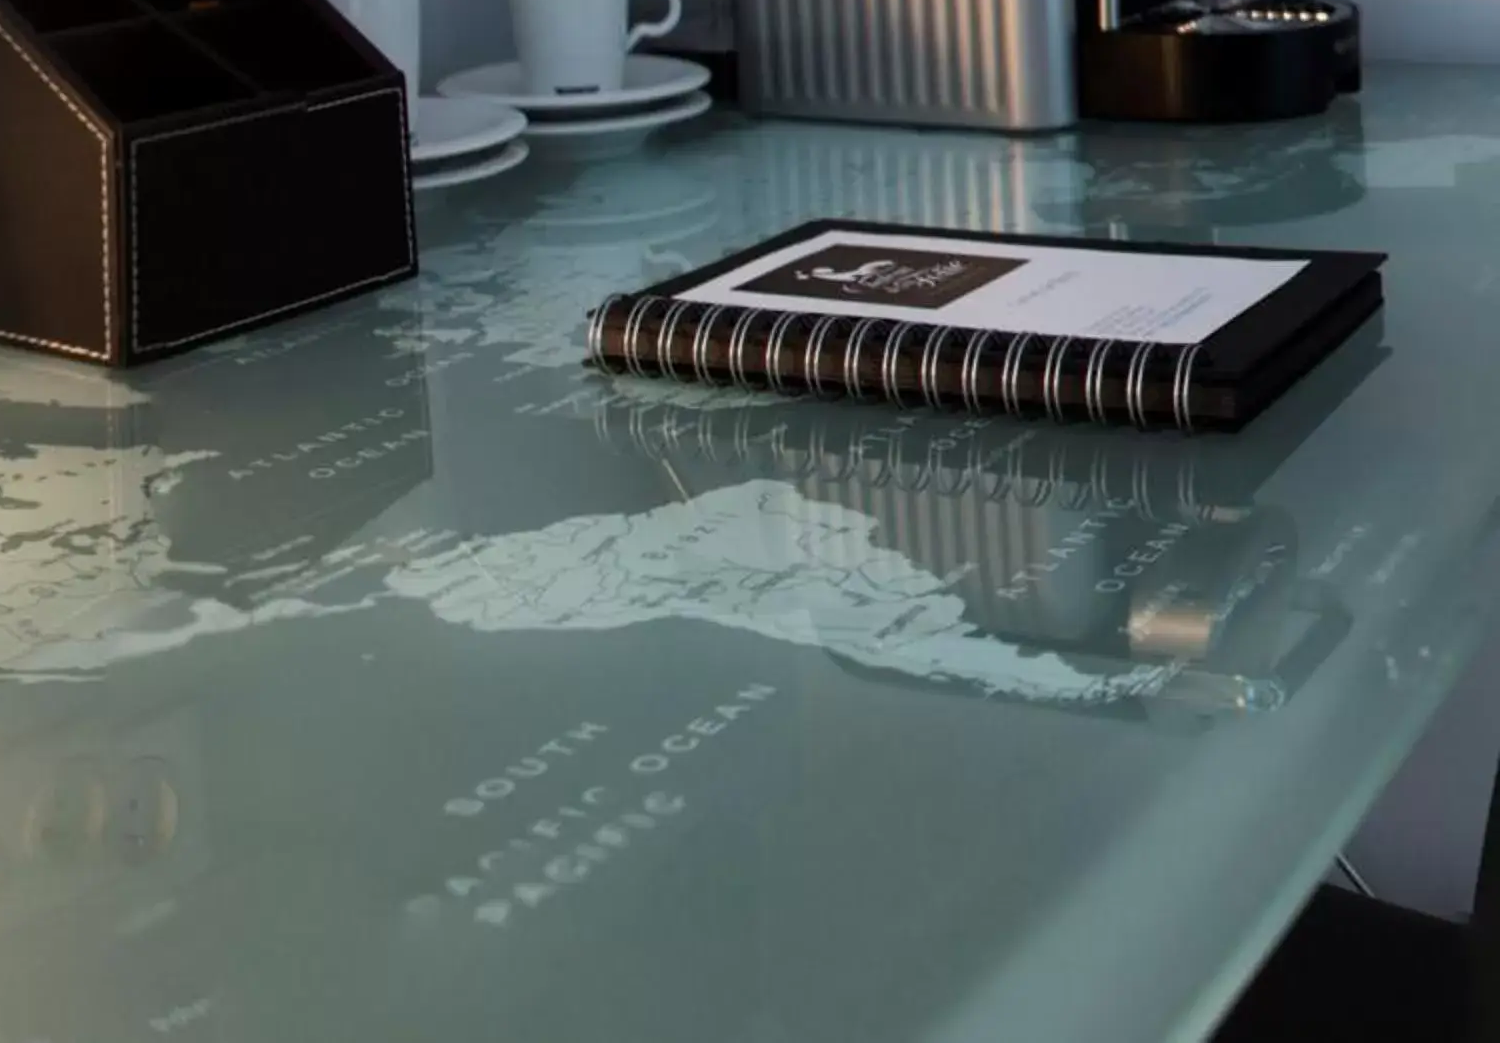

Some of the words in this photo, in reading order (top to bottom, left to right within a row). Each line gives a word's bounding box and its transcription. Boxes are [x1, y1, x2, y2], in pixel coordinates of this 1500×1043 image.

[227, 406, 406, 482] ATLANTIC
[307, 428, 429, 479] OCEAN
[996, 495, 1136, 601] ATLANTIC
[1094, 521, 1191, 594] OCEAN
[441, 719, 611, 819] SOUTH
[628, 681, 778, 776] OCEAN
